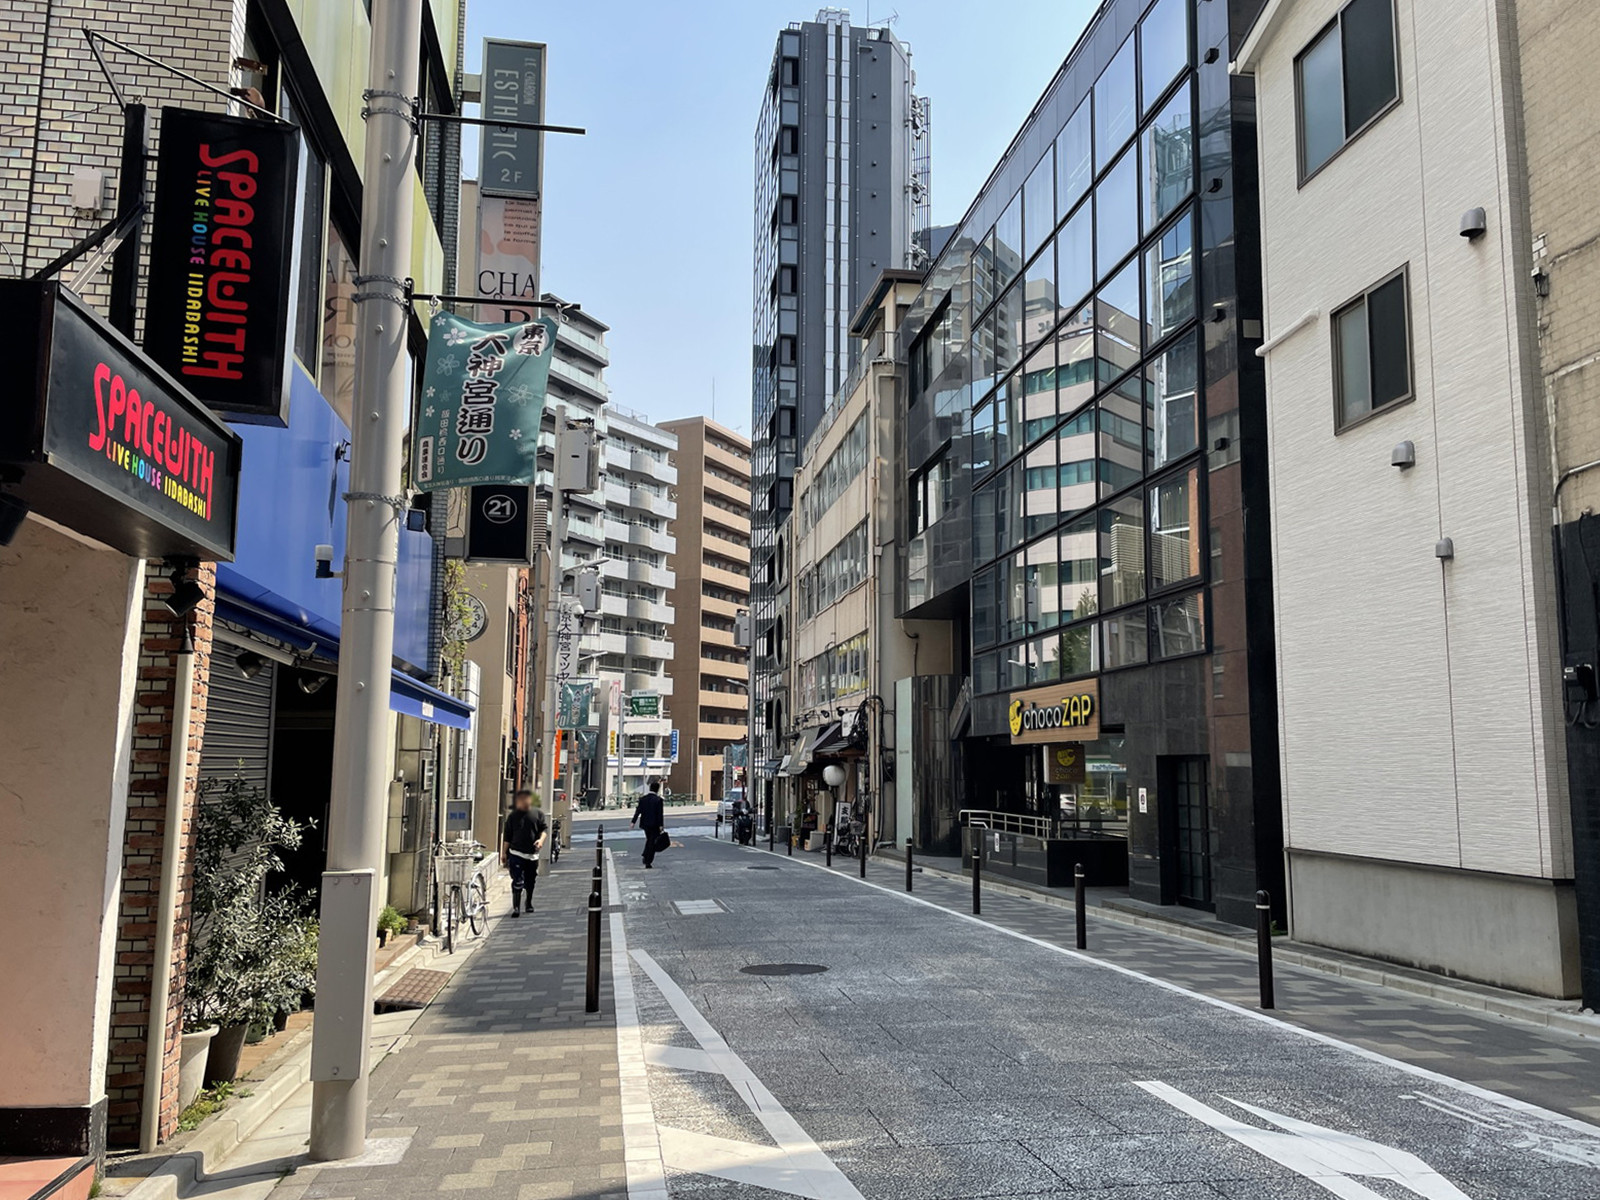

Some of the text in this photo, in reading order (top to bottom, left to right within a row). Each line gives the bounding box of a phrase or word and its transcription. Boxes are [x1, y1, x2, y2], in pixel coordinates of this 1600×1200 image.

[492, 68, 520, 161] ESTHTIC
[500, 168, 523, 184] 2F
[181, 143, 259, 380] SPACEWITH
[181, 170, 212, 364] LIVE HOUSE IIDABASHI
[518, 324, 545, 356] 東京
[88, 361, 215, 521] SPACEWITH
[457, 333, 510, 465] 大神宮通り
[106, 441, 207, 519] LIVE HOUSE IIDABASHI
[488, 500, 512, 517] 21
[1023, 694, 1092, 730] chocoZAP
